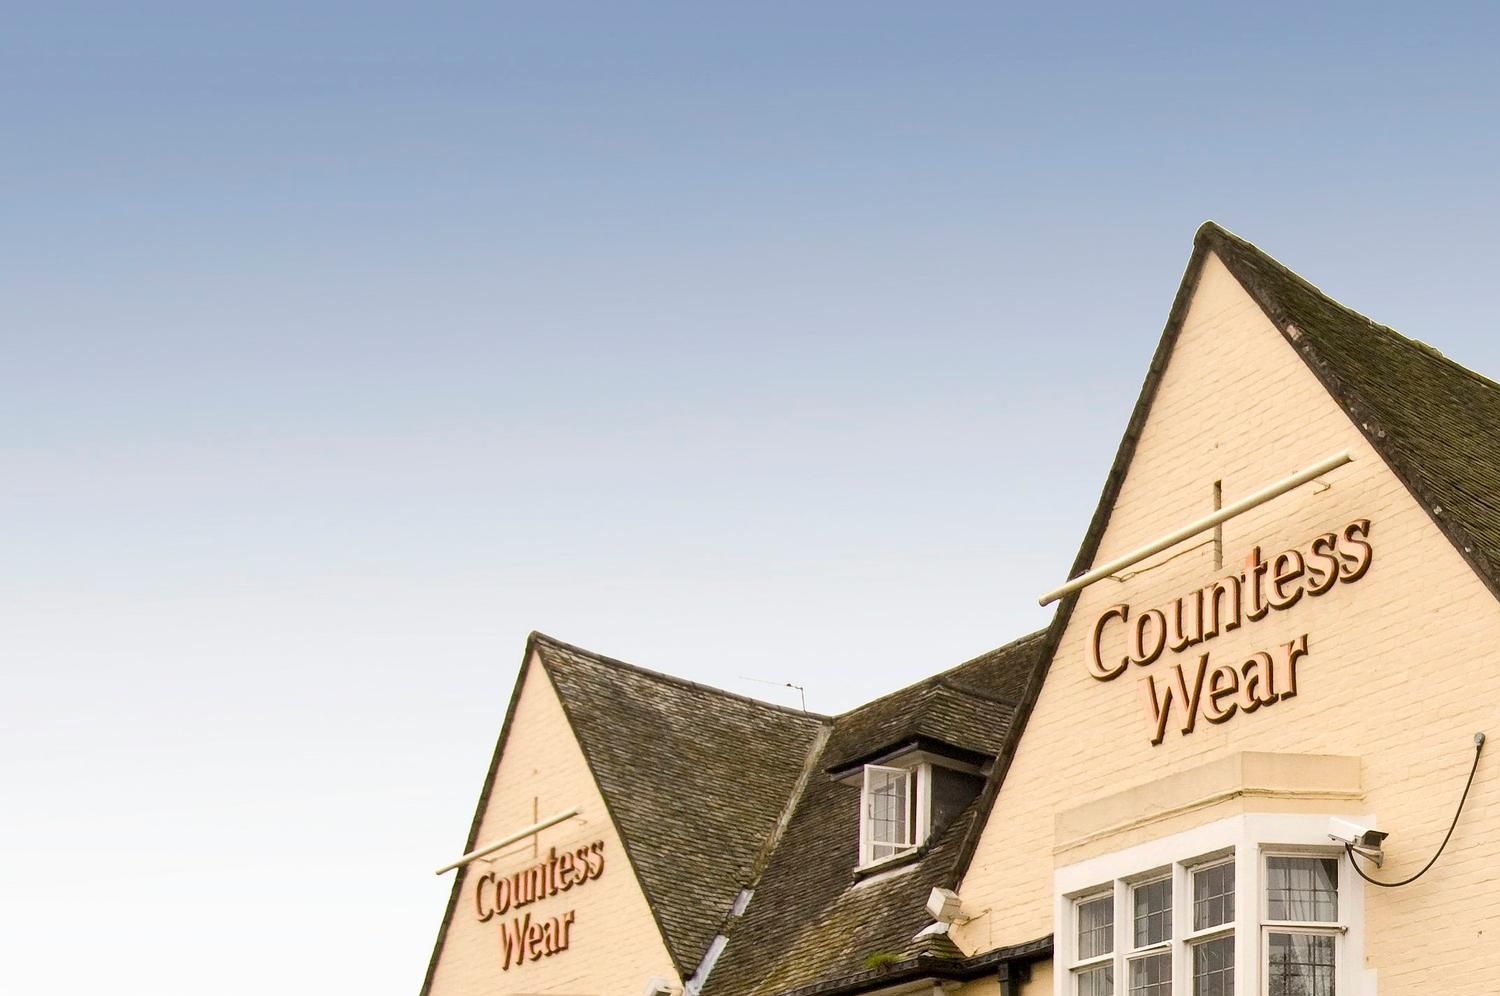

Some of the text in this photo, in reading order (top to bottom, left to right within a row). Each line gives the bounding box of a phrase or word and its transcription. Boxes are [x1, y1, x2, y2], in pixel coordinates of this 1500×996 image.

[1086, 519, 1374, 681] Countess
[1137, 633, 1309, 747] Wear
[475, 840, 605, 922] Countess
[497, 909, 575, 971] Wear
